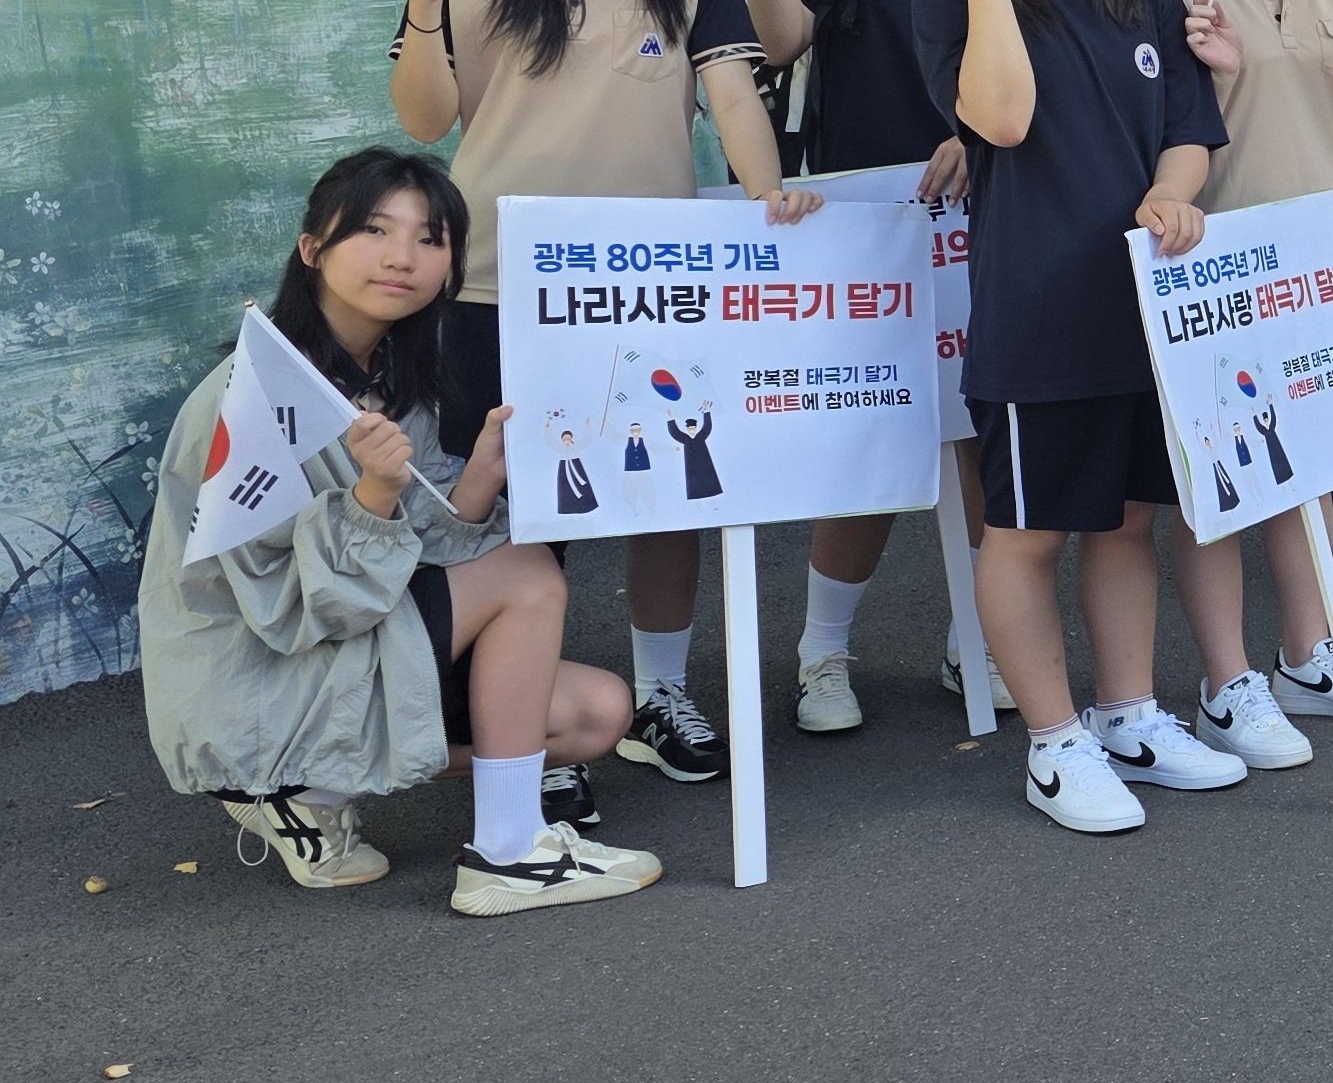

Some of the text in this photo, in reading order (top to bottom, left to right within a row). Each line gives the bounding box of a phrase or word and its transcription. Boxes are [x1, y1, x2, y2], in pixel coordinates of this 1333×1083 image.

[533, 242, 780, 273] 광복 80주년 기념
[1152, 243, 1280, 297] 광복 80주년 기념
[537, 281, 914, 326] 나라사랑 태극기 달기
[1162, 290, 1255, 345] 나라사랑
[1256, 272, 1314, 321] 태극기
[743, 364, 899, 387] 광복절 태극기 달기
[1282, 356, 1311, 378] 광복절
[744, 388, 913, 414] 이벤트에 참여하세요
[1287, 374, 1325, 401] 이벤트에
